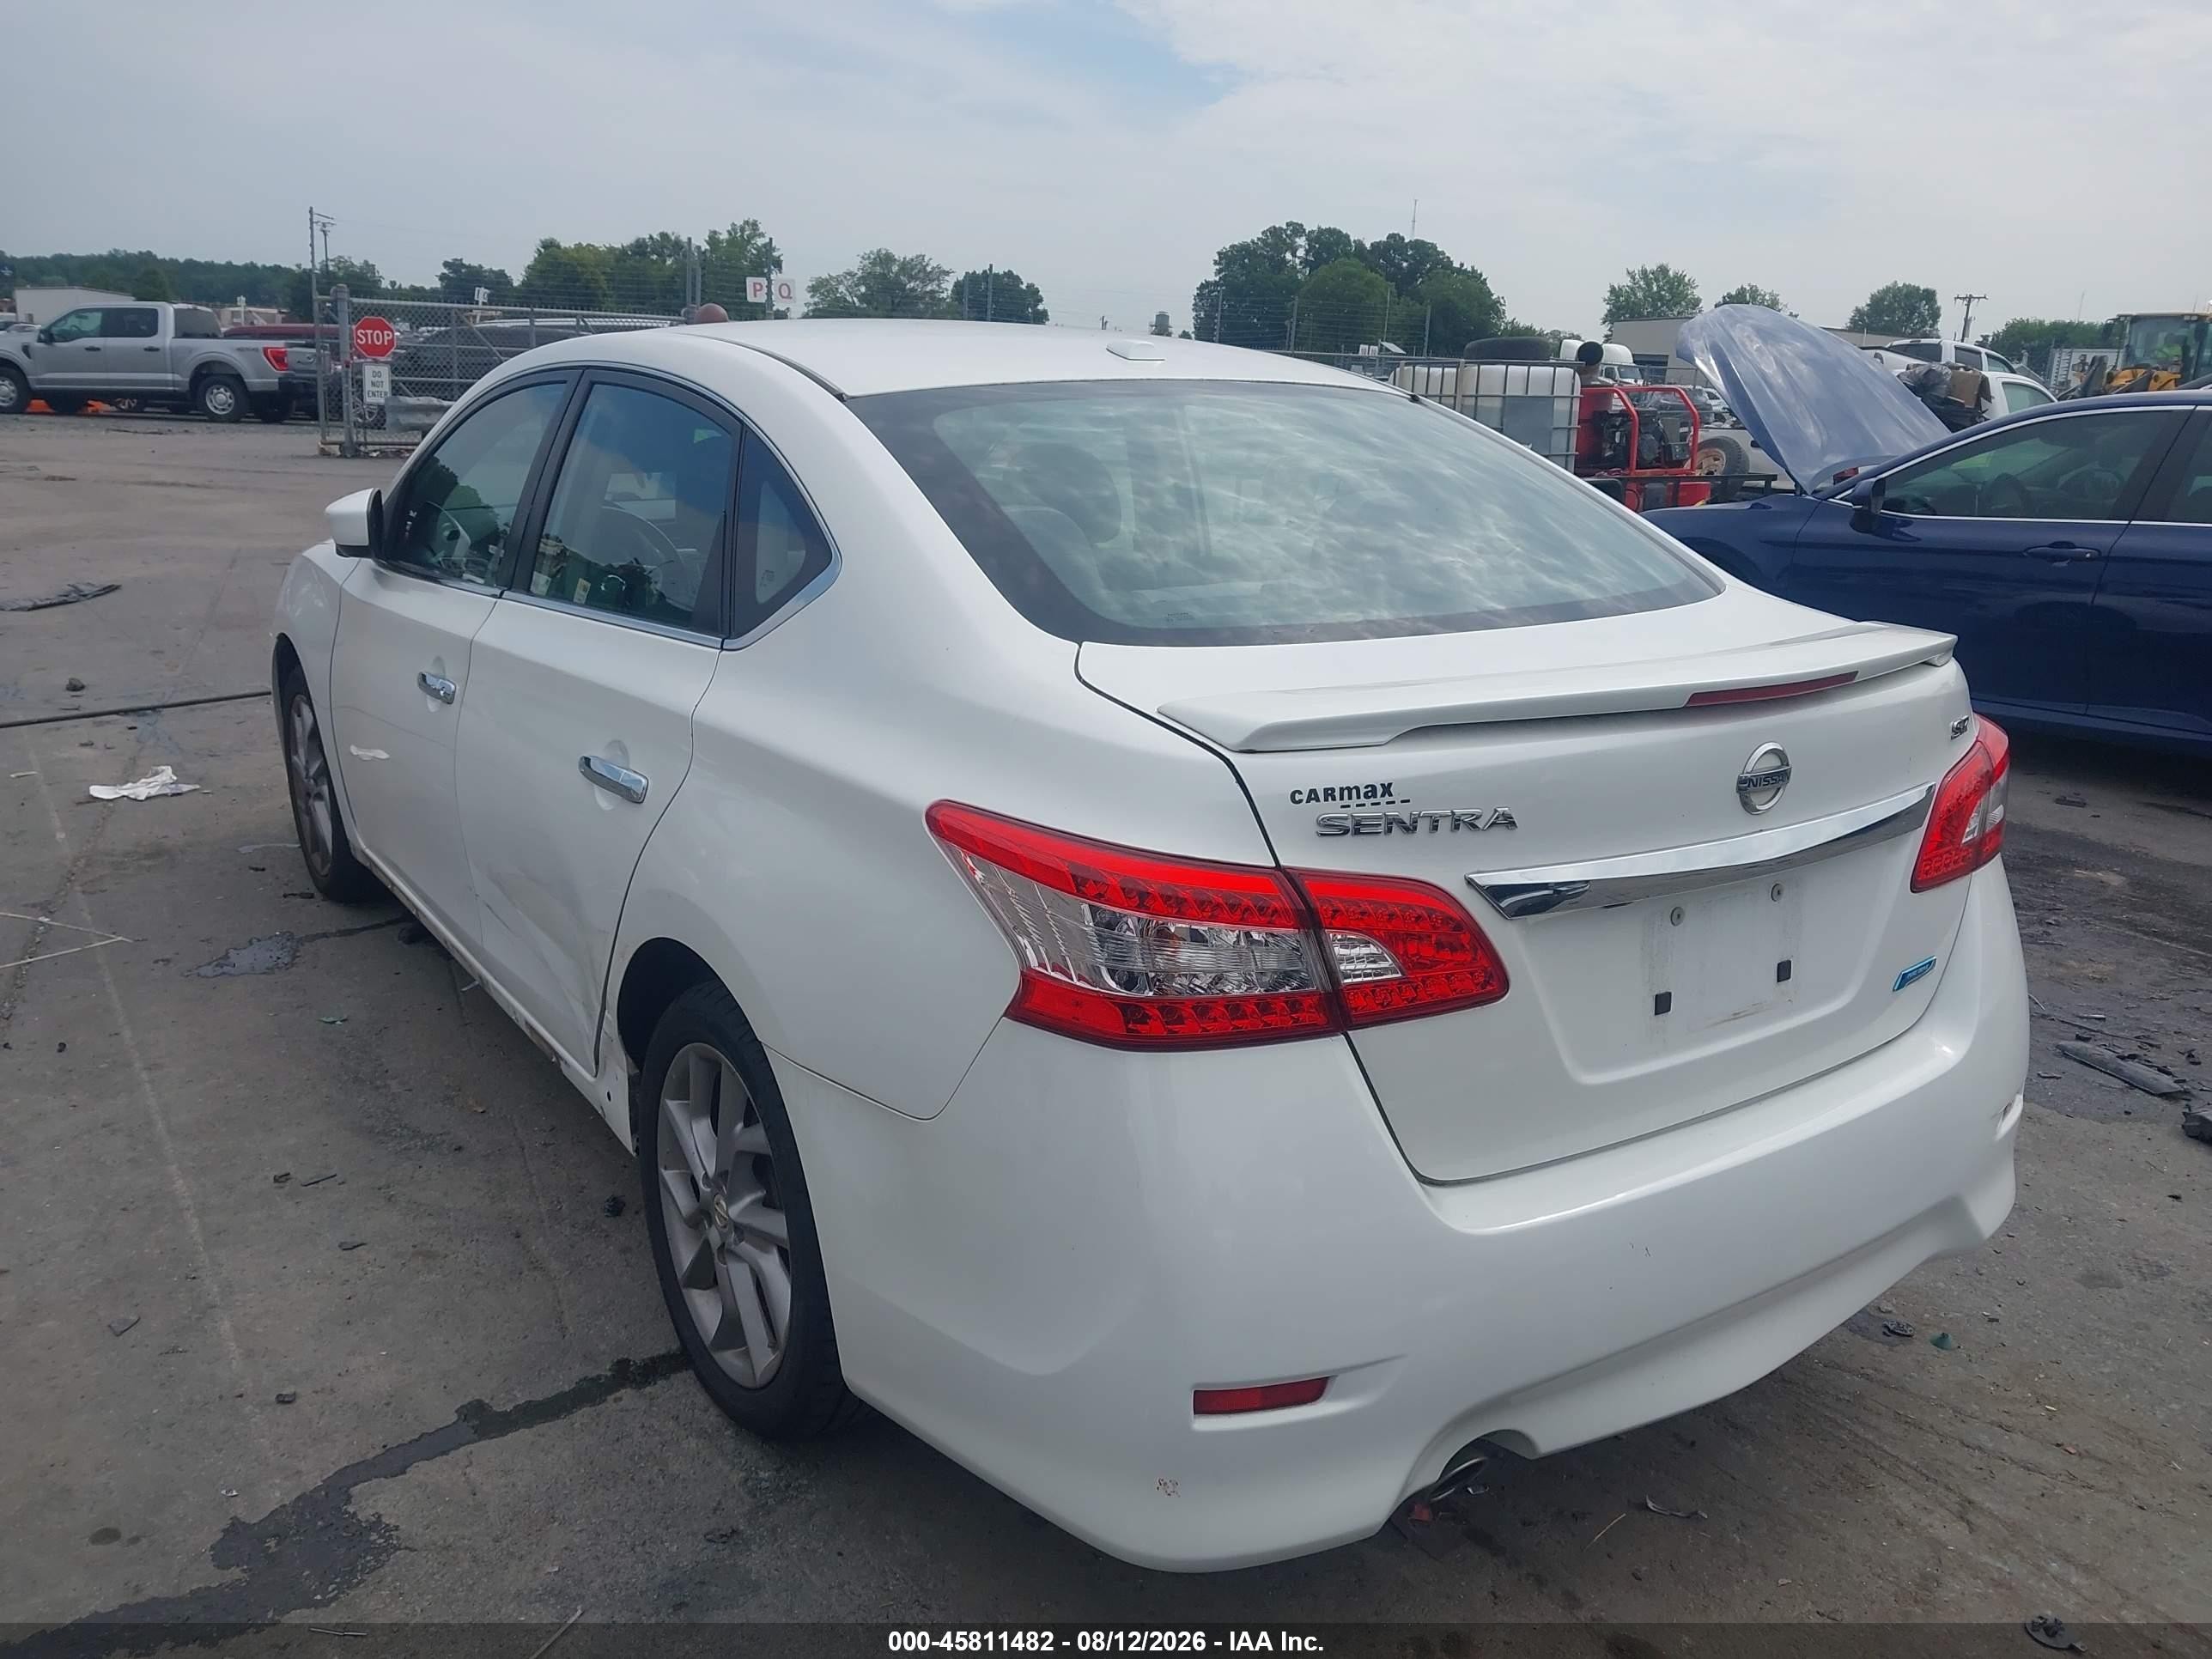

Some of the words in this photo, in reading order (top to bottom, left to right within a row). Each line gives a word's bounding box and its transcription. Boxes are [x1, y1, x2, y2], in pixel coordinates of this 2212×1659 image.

[753, 282, 763, 298] P
[778, 283, 793, 300] Q
[356, 329, 393, 345] STOP
[372, 370, 382, 379] DO
[370, 380, 385, 389] NOT
[1316, 806, 1518, 836] SENTRA
